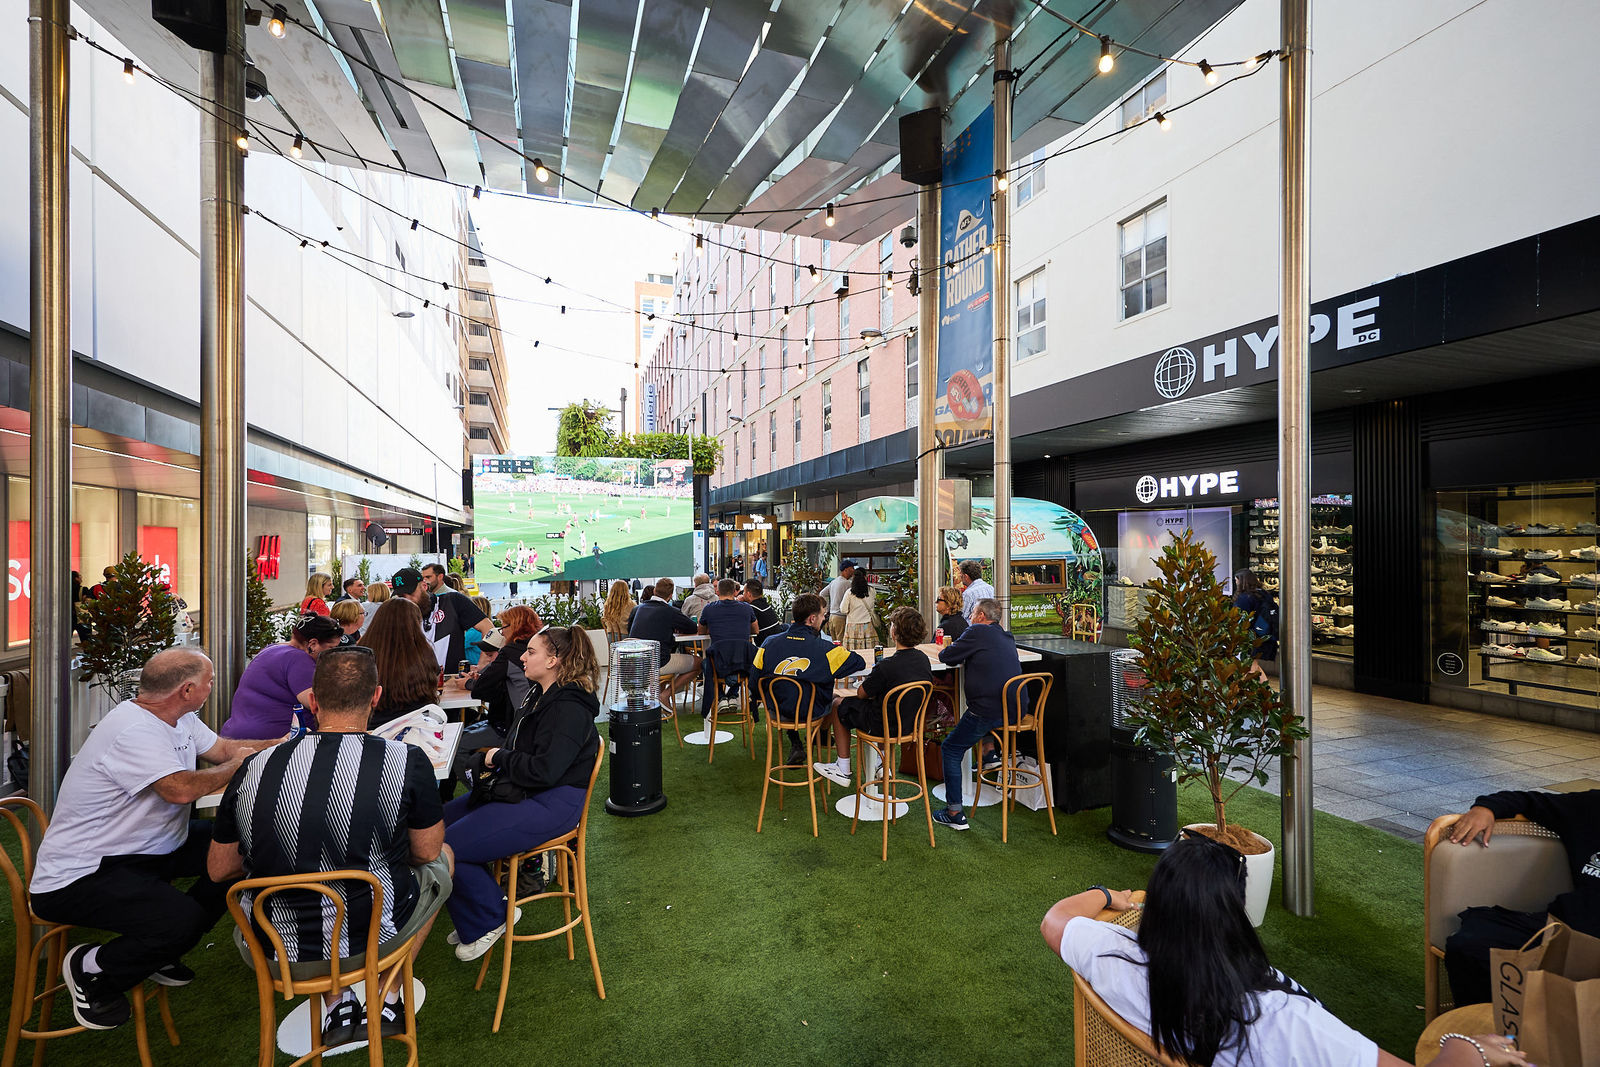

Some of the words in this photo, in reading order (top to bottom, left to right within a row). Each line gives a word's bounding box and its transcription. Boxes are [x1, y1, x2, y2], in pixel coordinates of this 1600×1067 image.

[944, 224, 987, 280] GATHER
[946, 259, 985, 309] ROUND
[1203, 296, 1380, 383] HYPE
[1358, 331, 1377, 343] DC
[1160, 470, 1239, 498] HYPE
[1010, 603, 1023, 611] here
